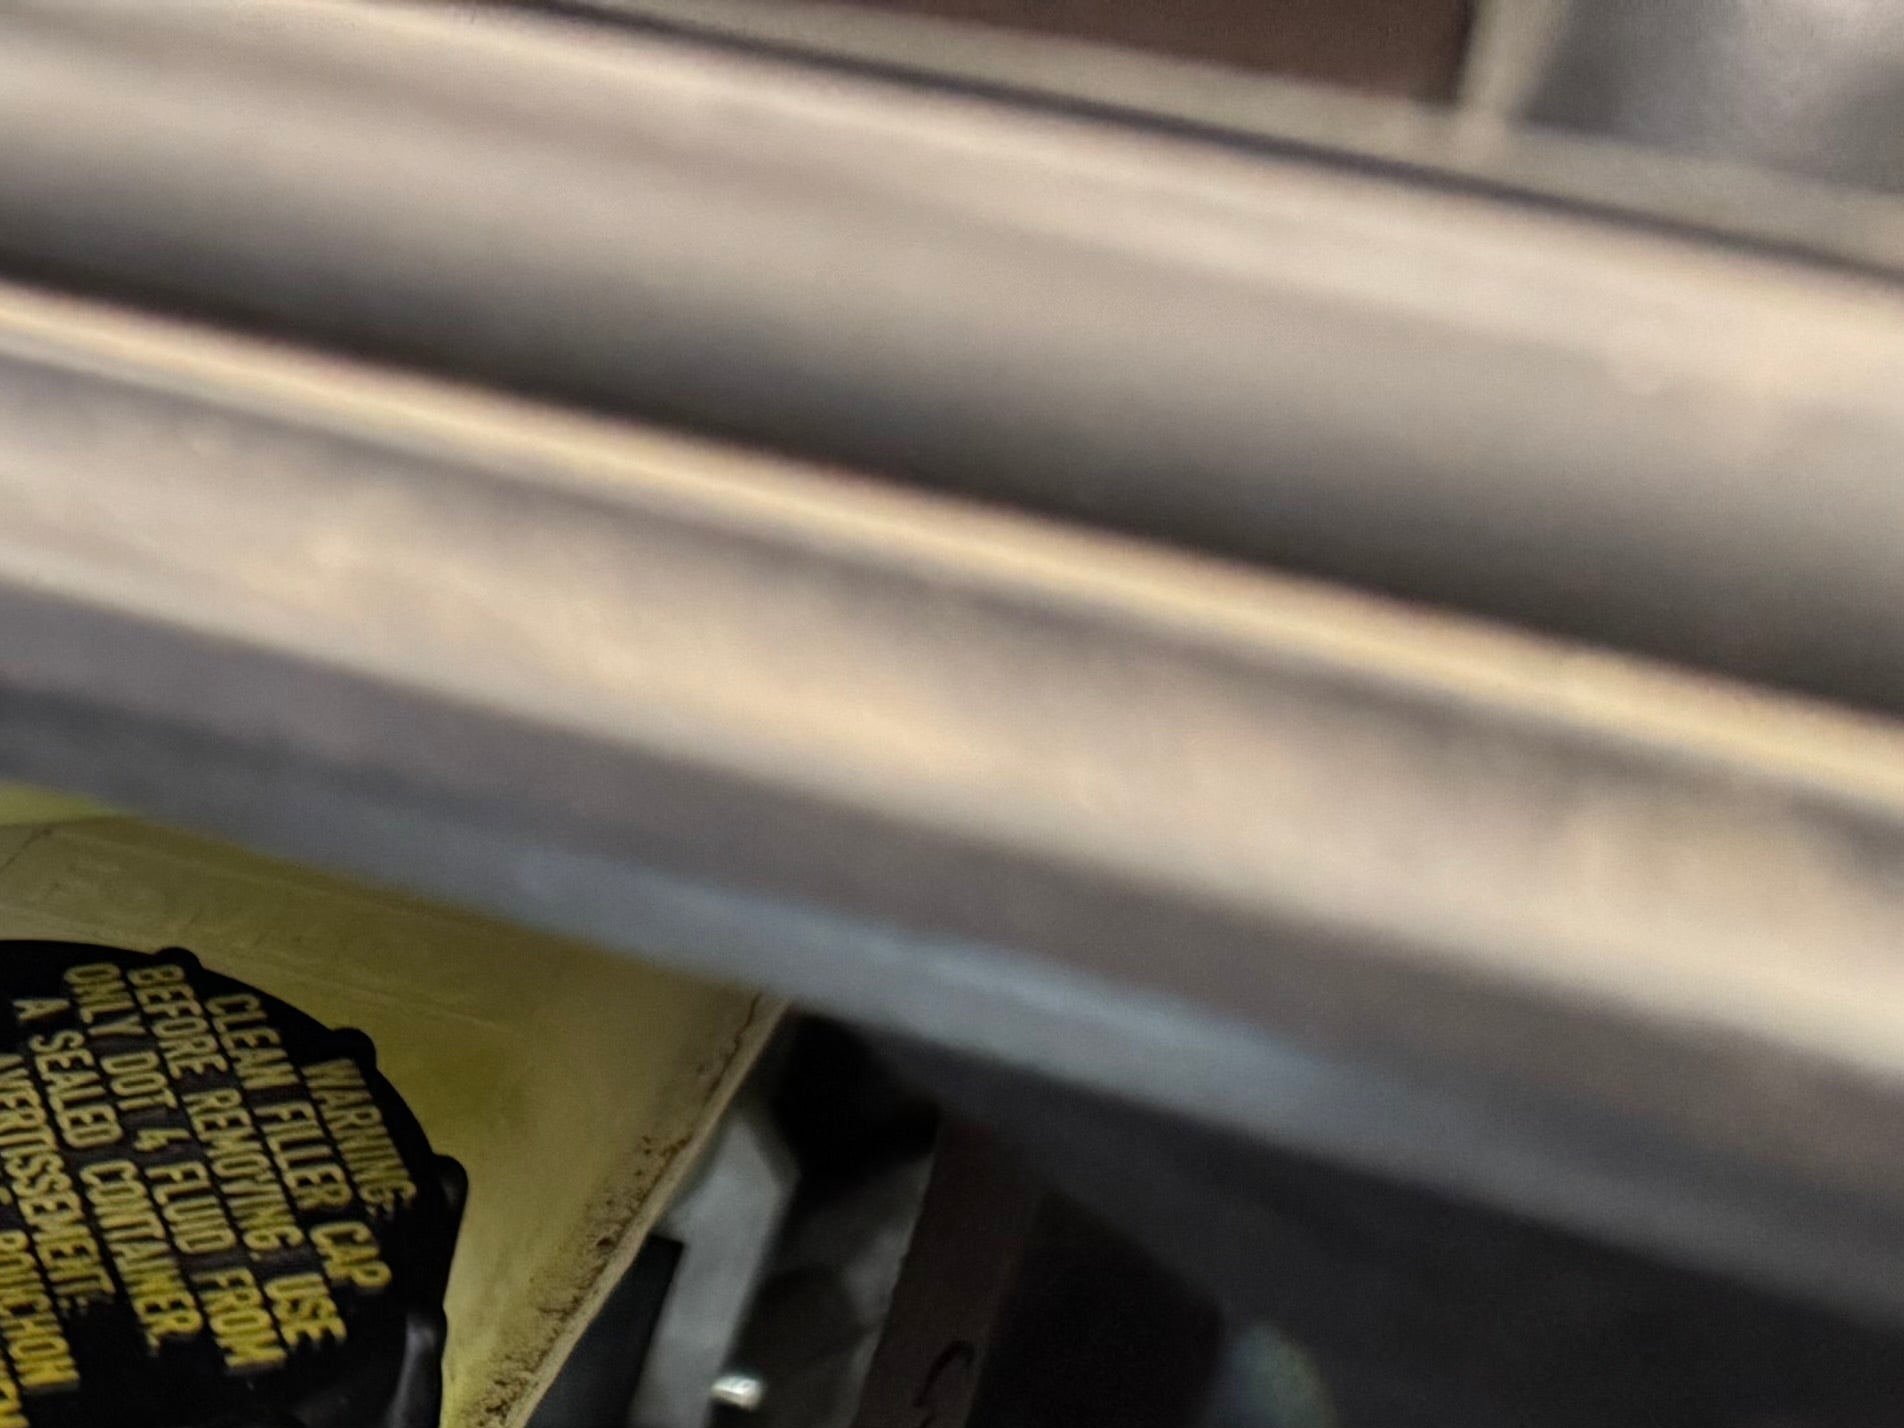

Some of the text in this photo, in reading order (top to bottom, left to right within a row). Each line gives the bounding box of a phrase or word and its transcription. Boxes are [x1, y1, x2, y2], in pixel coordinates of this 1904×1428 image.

[12, 999, 204, 1358] A SEALED CONTAINER.
[63, 963, 287, 1369] ONLY DOT 4 FLUID FROM
[128, 964, 347, 1349] BEFORE REMOVING. USE
[206, 993, 393, 1288] CLEAN FILLER CAP
